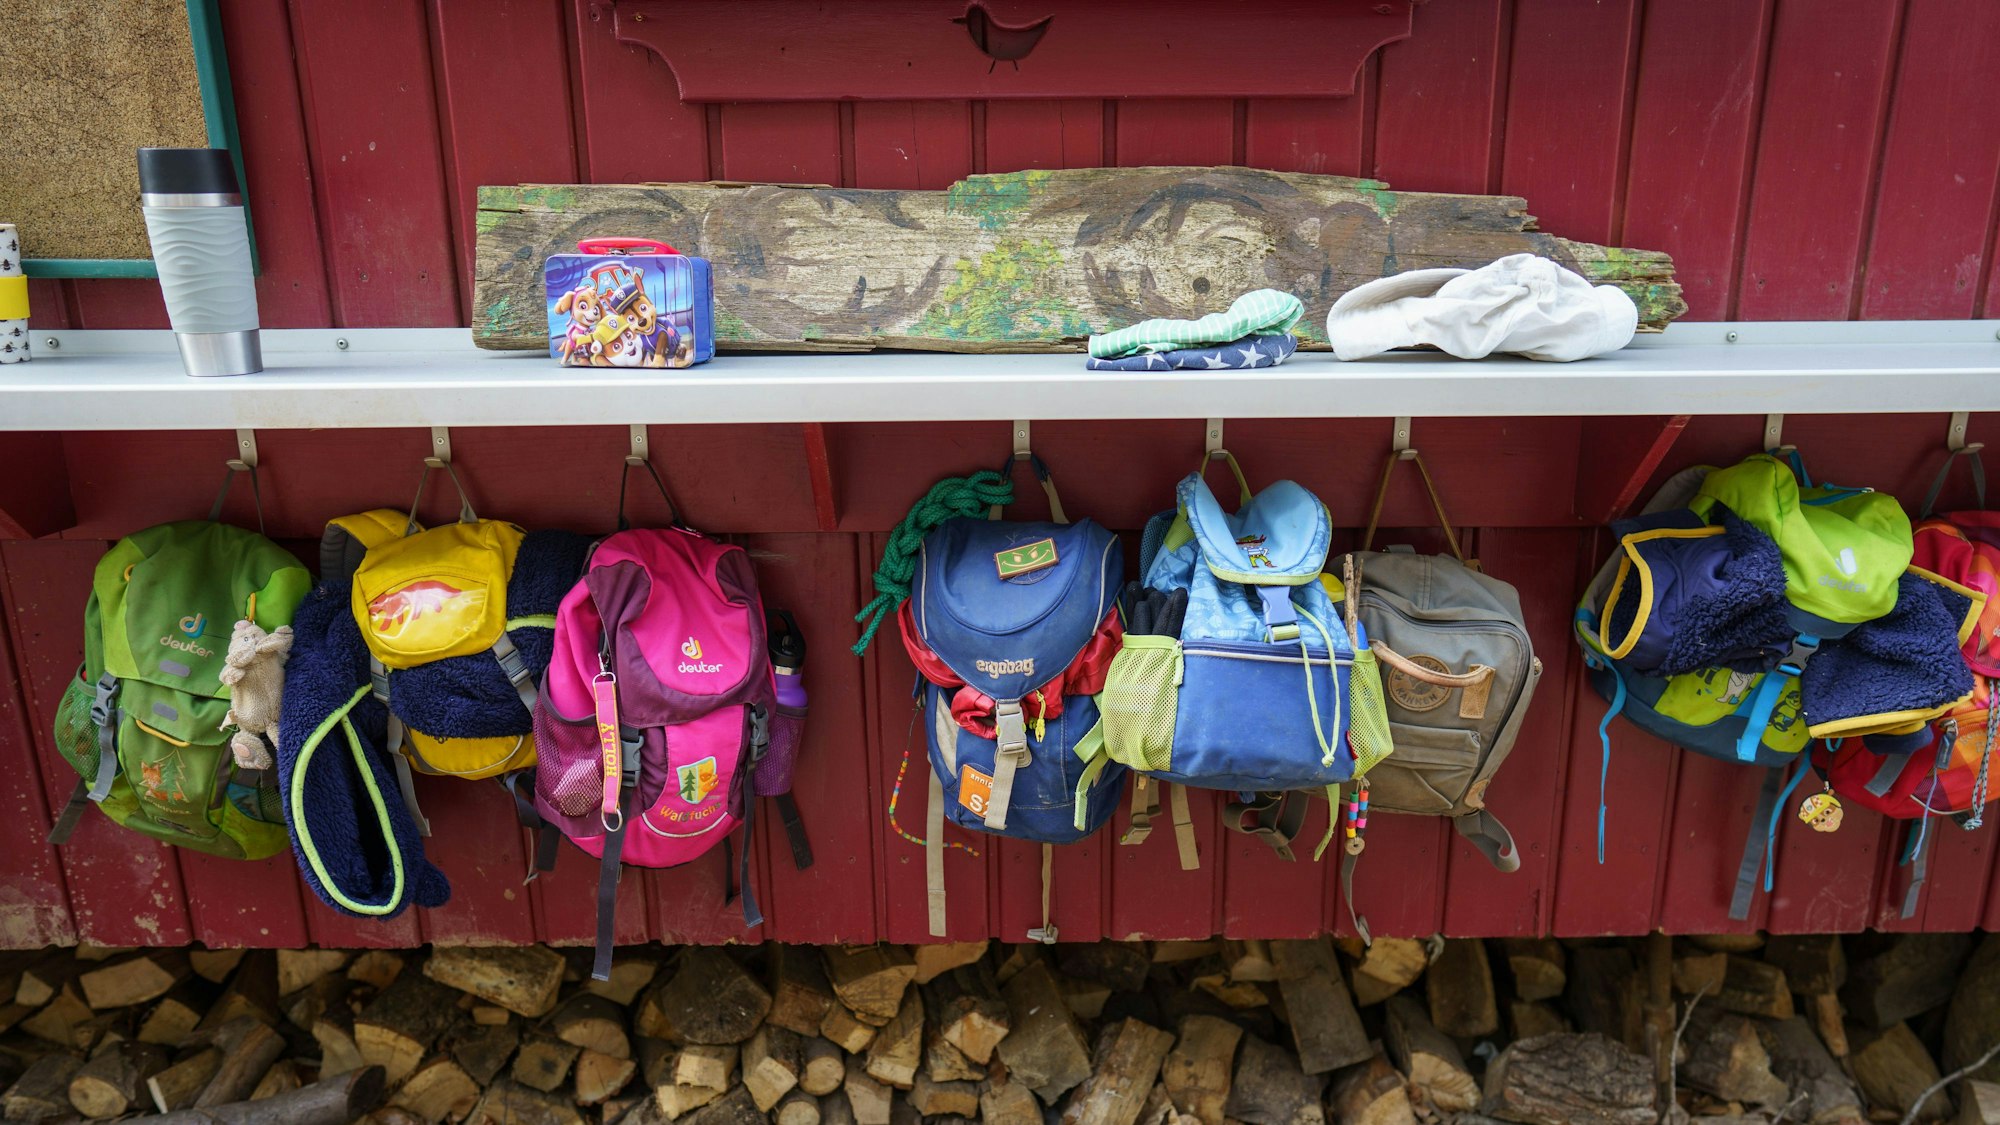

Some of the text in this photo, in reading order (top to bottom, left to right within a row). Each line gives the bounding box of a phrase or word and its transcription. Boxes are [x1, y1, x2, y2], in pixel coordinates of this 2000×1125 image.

[160, 634, 214, 658] deuter
[677, 661, 723, 673] deuter
[975, 657, 1035, 679] ergobag
[600, 722, 617, 777] HOLLY
